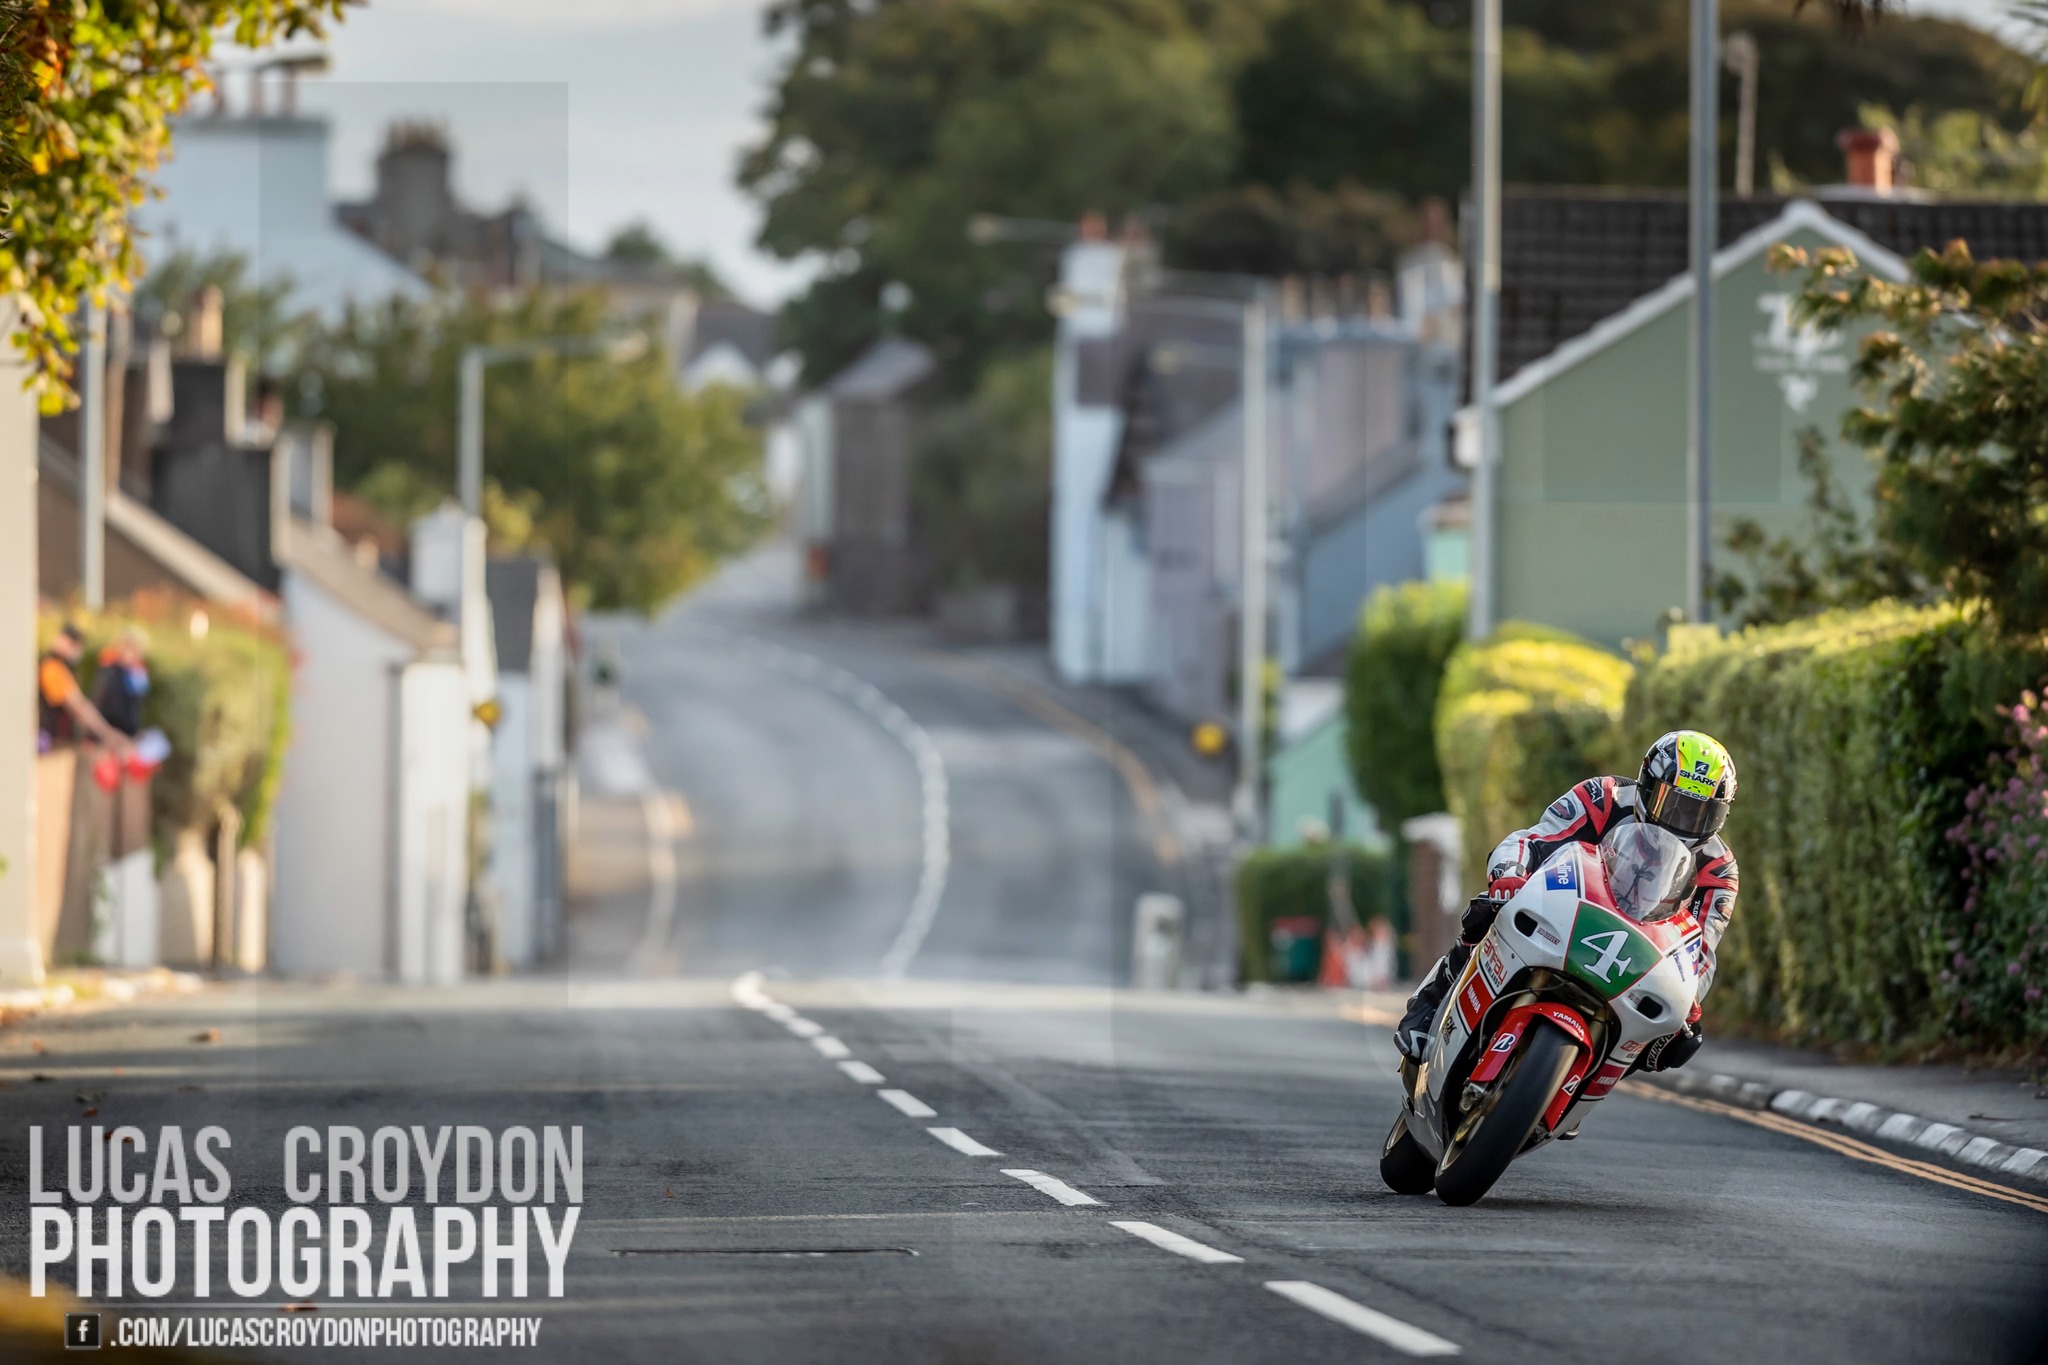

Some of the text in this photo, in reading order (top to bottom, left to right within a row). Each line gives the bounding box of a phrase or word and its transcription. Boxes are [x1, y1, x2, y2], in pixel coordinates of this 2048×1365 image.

[1680, 769, 1716, 787] SHARK
[1580, 930, 1633, 984] 4
[1552, 1011, 1585, 1041] YAMAHA
